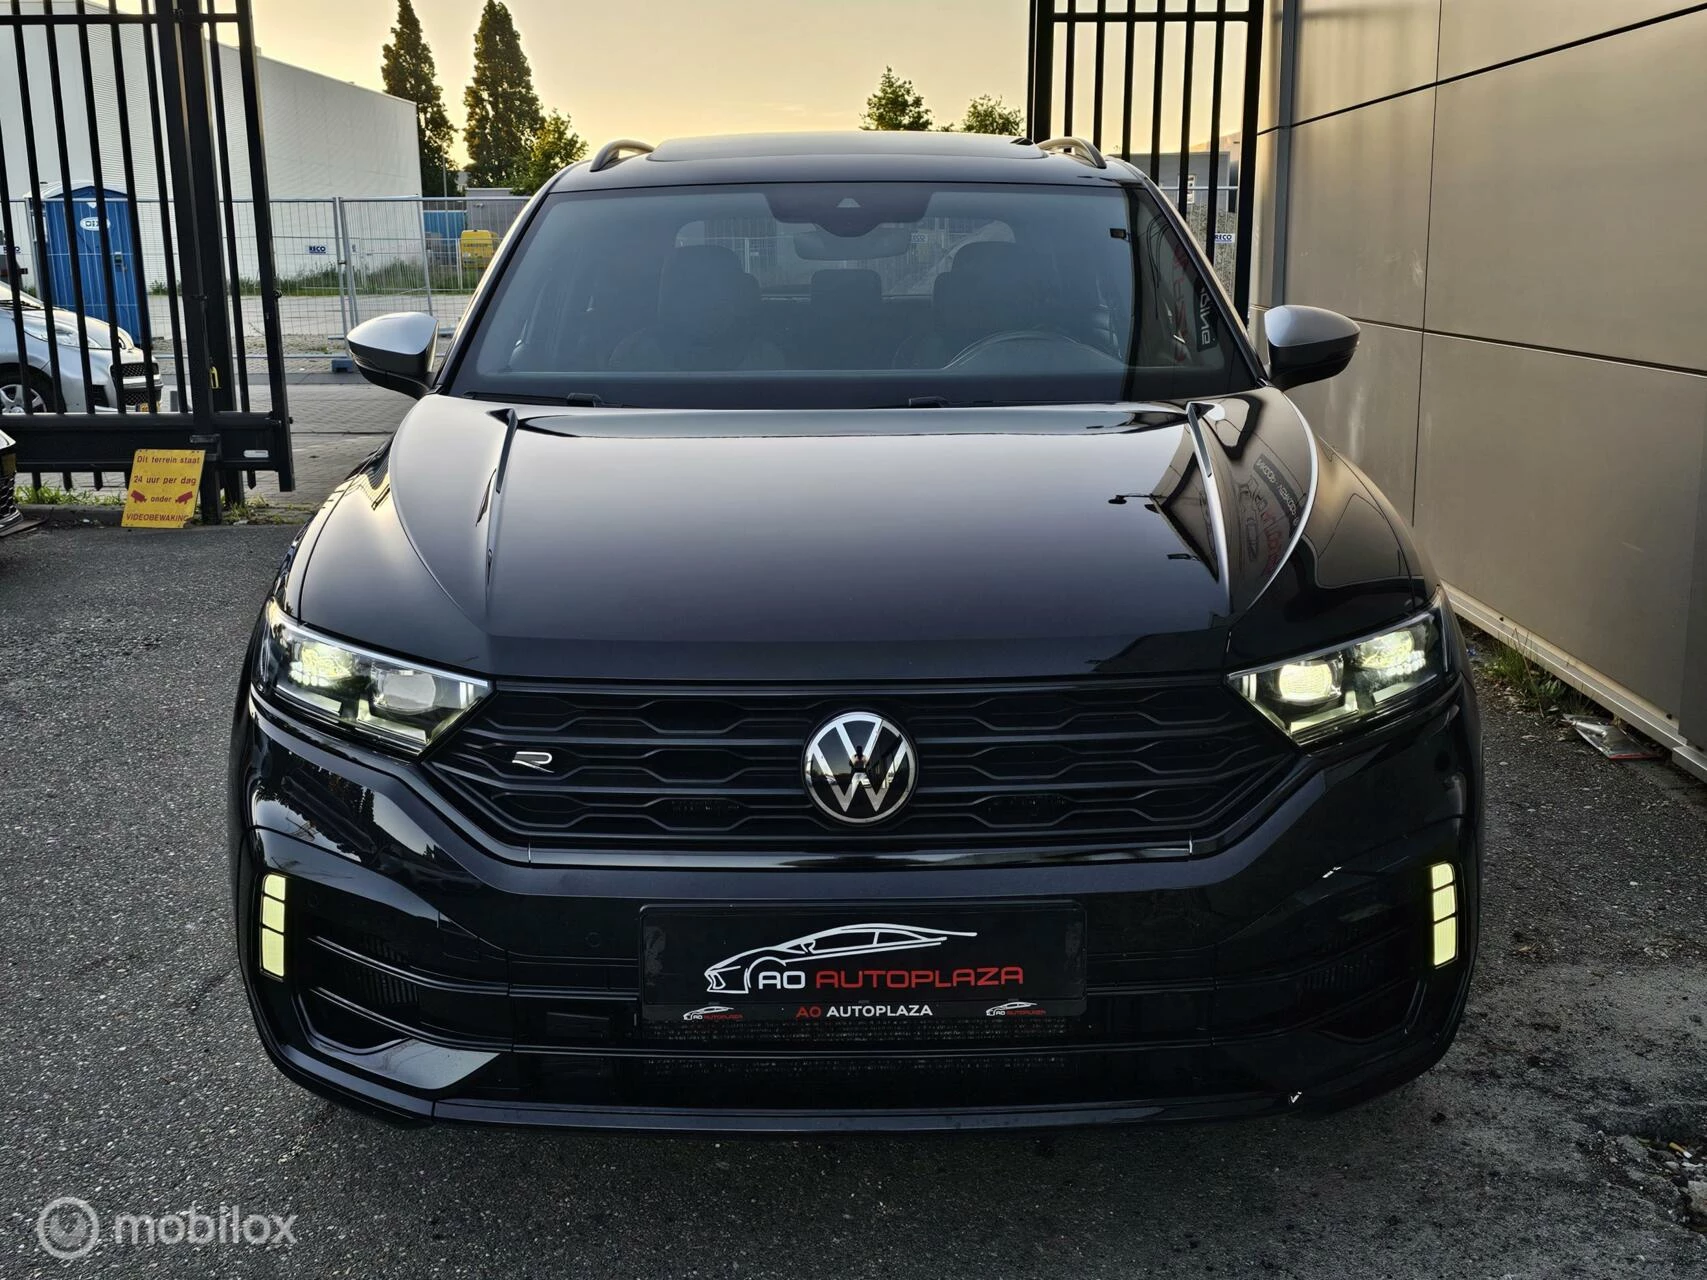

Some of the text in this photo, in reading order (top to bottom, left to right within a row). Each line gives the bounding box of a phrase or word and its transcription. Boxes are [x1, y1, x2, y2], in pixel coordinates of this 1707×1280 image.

[136, 455, 200, 464] Dit terrein staat
[133, 475, 197, 486] 24 uur per dag
[512, 750, 555, 773] R
[758, 967, 1024, 990] AO AUTOPLAZA
[796, 1004, 934, 1018] AO AUTOPLAZA
